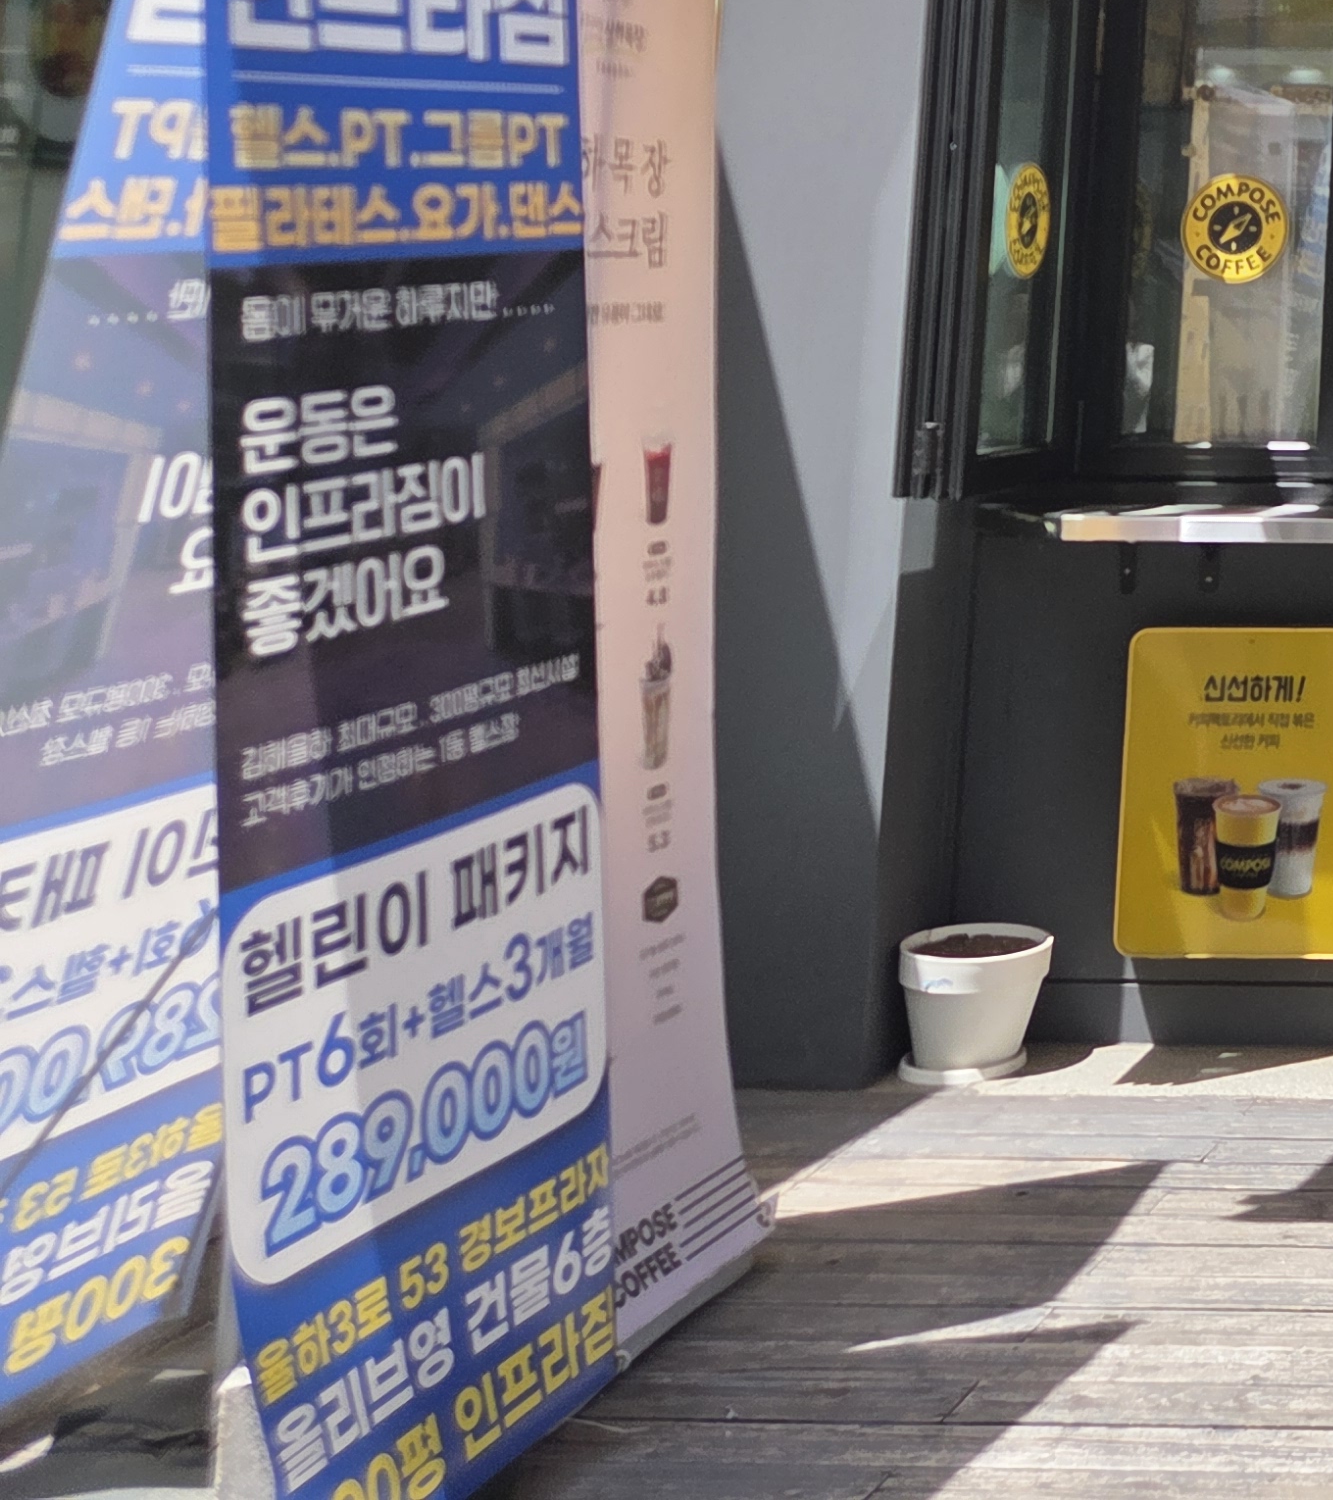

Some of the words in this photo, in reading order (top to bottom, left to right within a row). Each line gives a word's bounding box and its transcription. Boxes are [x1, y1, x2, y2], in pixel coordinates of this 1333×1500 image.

[1192, 181, 1281, 225] COMPOSE
[1196, 244, 1272, 277] COFFEE
[239, 384, 398, 476] 운동은
[241, 451, 486, 567] 인프라짐이
[241, 545, 449, 657] 좋겠어요
[1203, 675, 1306, 703] 신선하게!
[239, 873, 431, 1017] 헬린이
[450, 804, 591, 930] 패키지
[259, 1005, 591, 1260] 289,000원
[399, 1242, 449, 1310] 53
[459, 1142, 611, 1274] 경보프라자
[614, 1202, 678, 1266] MPOSE
[274, 1306, 456, 1494] 올리브영
[465, 1204, 613, 1357] 건물6층
[454, 1282, 615, 1464] 인프라짐
